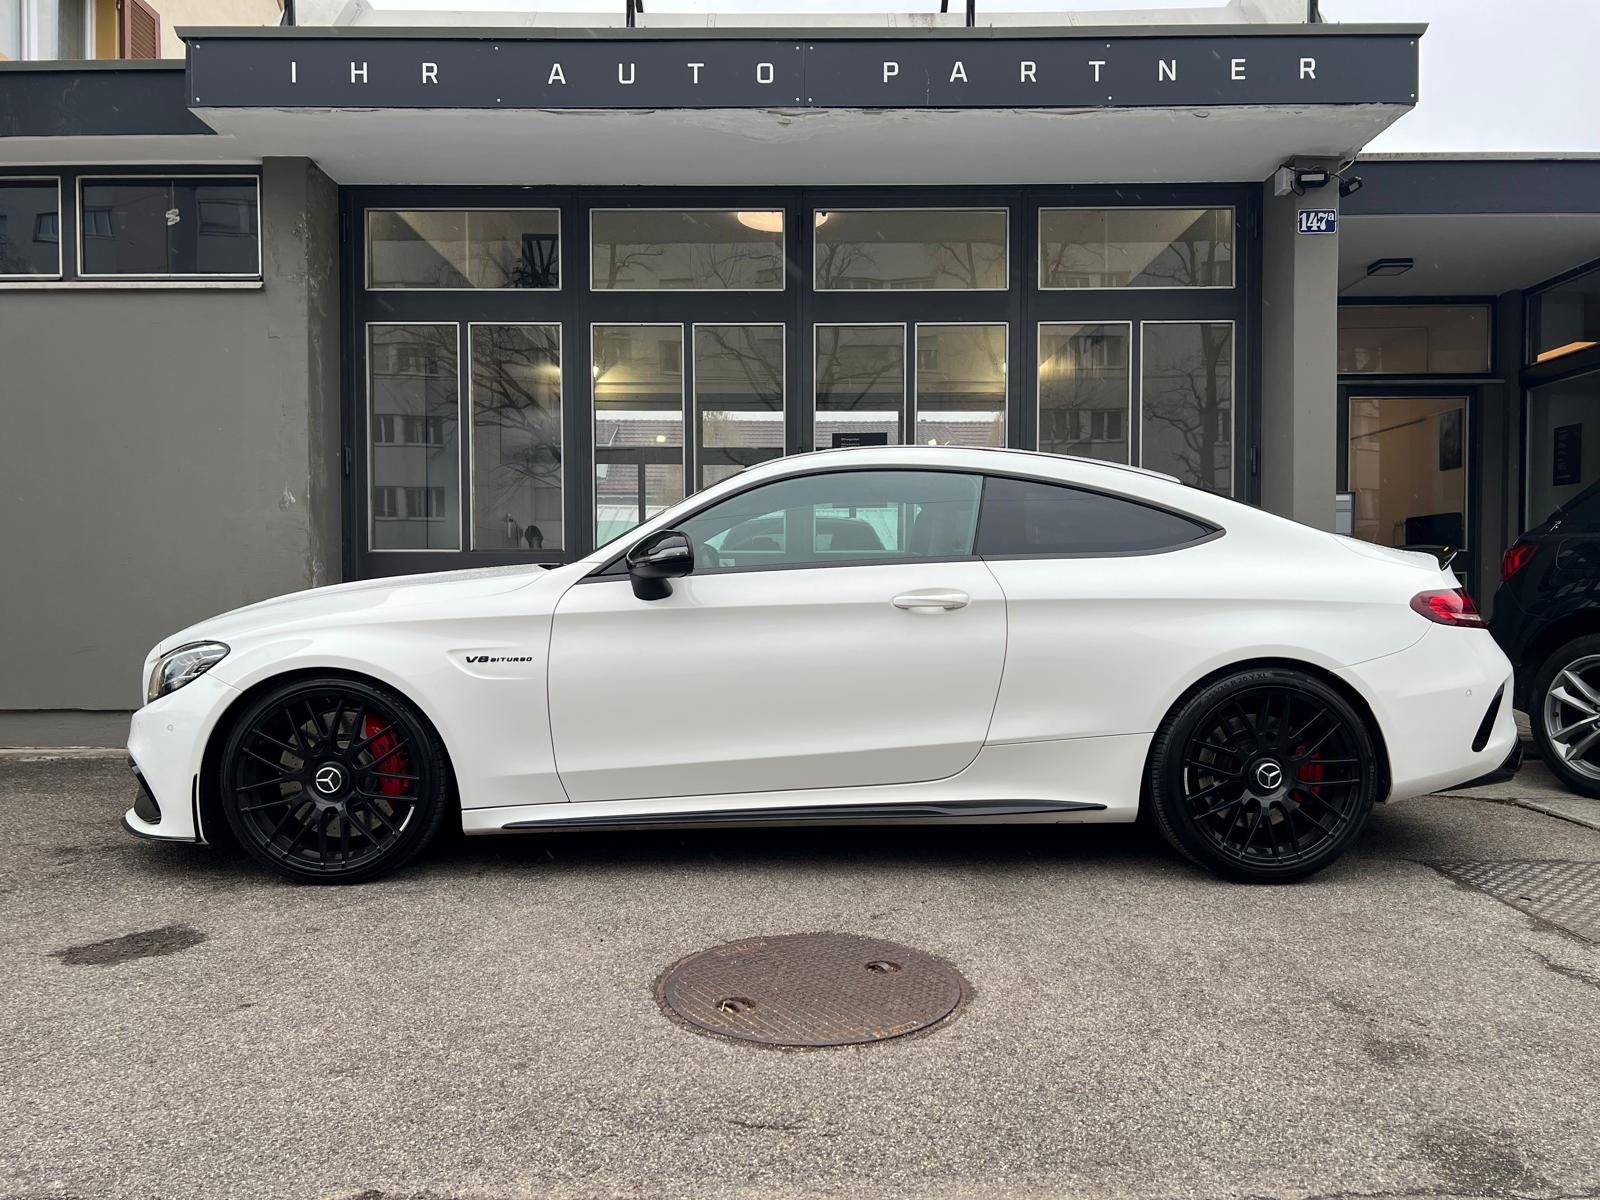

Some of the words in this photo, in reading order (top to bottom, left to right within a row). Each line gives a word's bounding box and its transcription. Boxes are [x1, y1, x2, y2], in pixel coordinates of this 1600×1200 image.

[291, 61, 439, 84] IHR
[547, 62, 774, 85] AUTO
[883, 57, 1318, 83] PARTNER
[1300, 212, 1335, 231] 147a
[465, 655, 489, 664] V8
